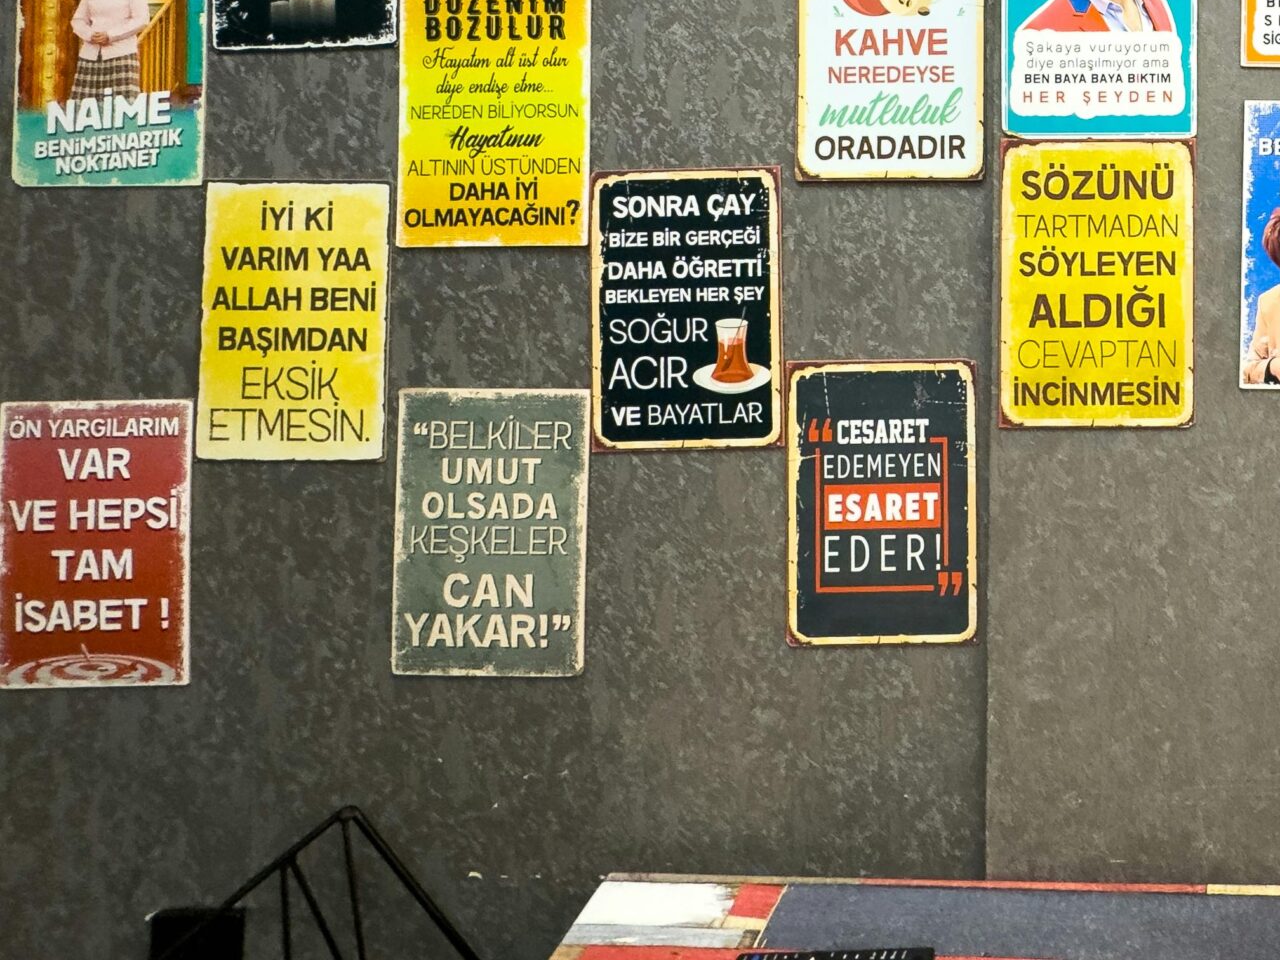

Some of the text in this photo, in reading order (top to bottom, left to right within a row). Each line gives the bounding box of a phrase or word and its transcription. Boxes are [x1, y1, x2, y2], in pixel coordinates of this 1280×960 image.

[425, 15, 566, 41] BOZULUR
[835, 28, 948, 56] KAHVE
[422, 46, 568, 79] Hayatım alt üst olur
[1026, 42, 1170, 55] Şakaya vuruyorum
[828, 65, 954, 84] NEREDEYSE
[1025, 73, 1171, 83] BEN BAYA BAYA BIKTIM
[1143, 60, 1169, 68] ama
[436, 73, 464, 103] diye
[469, 72, 506, 98] endişe
[1023, 91, 1173, 105] HER ŞEYDEN
[47, 88, 172, 134] NAİME
[411, 101, 579, 120] NEREDEN BİLİYORSUN
[819, 87, 963, 128] mutluluk
[446, 124, 544, 159] Hayatının
[814, 135, 966, 160] ORADADIR
[55, 149, 161, 175] NOKTANET
[407, 155, 581, 176] ALTININ ÜSTÜNDEN
[450, 177, 538, 201] DAHA İYİ
[1021, 163, 1174, 201] SÖZÜNÜ
[261, 200, 333, 231] İYİ Kİ
[404, 200, 580, 227] OLMAYACAĞINI?
[613, 194, 756, 221] SONRA ÇAY
[609, 226, 760, 248] BİZE BİR GERÇEĞİ
[1017, 214, 1178, 238] TARTMADAN
[221, 246, 371, 271] VARIM YAA
[607, 254, 762, 280] DAHA ÖĞRETTİ
[1019, 245, 1176, 277] SÖYLEYEN
[212, 281, 376, 312] ALLAH BENİ
[605, 286, 765, 304] BEKLEYEN HER ŞEY
[1029, 285, 1165, 328] ALDIĞI
[218, 327, 367, 357] BAŞIMDAN
[609, 313, 708, 345] SOĞUR
[1018, 339, 1177, 368] CEVAPTAN
[241, 360, 340, 400] EKSİK
[608, 356, 688, 390] ACIR
[1013, 376, 1180, 406] İNCİNMESİN
[9, 415, 179, 438] ÖN YARGILARIM
[209, 402, 370, 442] ETMESİN.
[611, 402, 763, 426] VE BAYATLAR
[58, 448, 131, 480] VAR
[442, 457, 541, 485] UMUT
[824, 453, 941, 479] EDEMEYEN
[9, 489, 178, 532] VE HEPSİ
[422, 491, 558, 520] OLSADA
[828, 492, 938, 523] ESARET
[410, 525, 568, 563] KEŞKELER
[51, 548, 133, 581] TAM
[443, 572, 534, 608] CAN
[15, 592, 147, 633] İSABET
